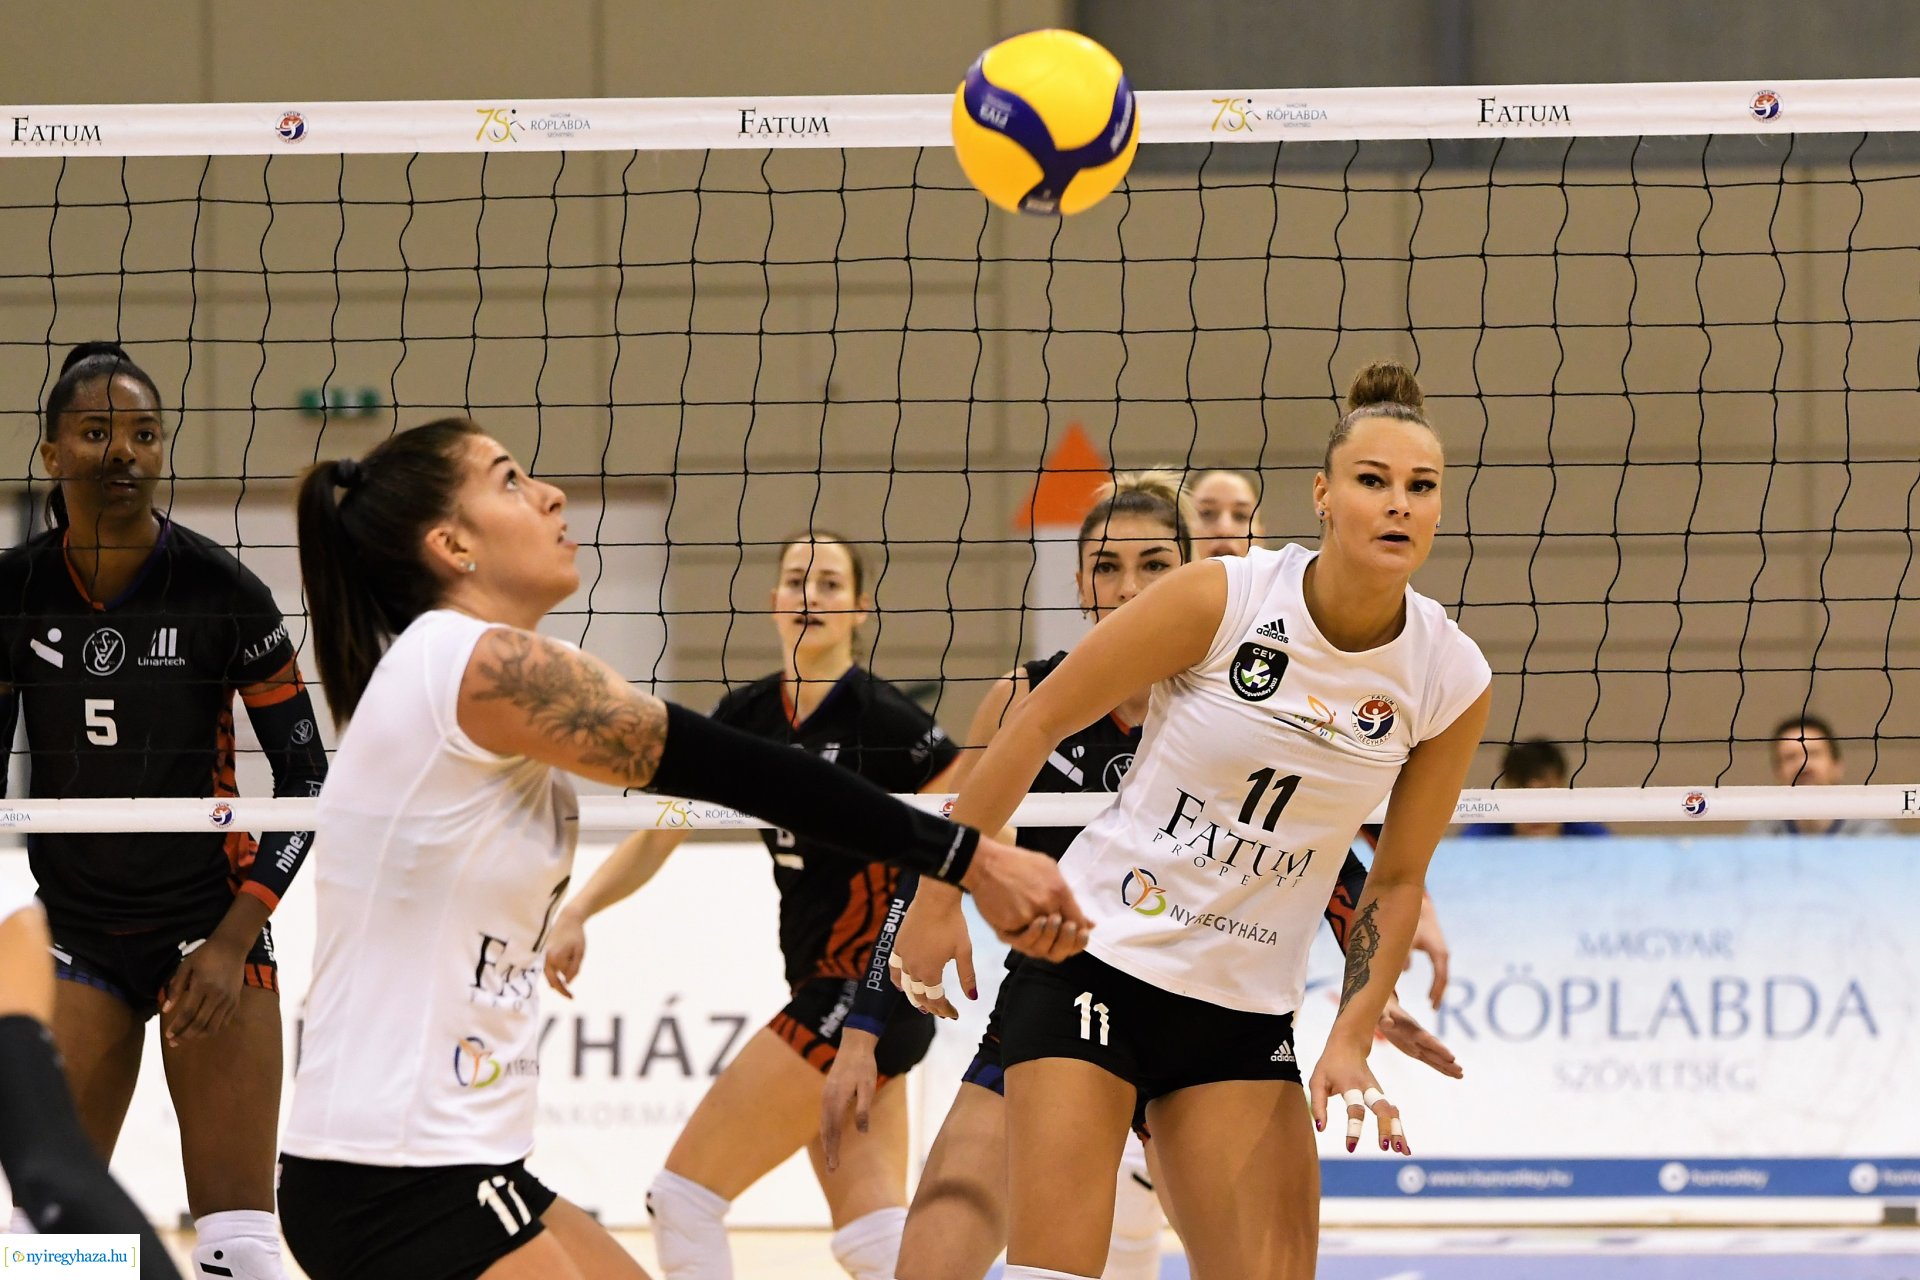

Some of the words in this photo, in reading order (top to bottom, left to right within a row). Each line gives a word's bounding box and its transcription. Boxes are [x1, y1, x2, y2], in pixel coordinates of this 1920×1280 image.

[530, 118, 591, 131] RÖPLABDA
[1266, 108, 1328, 121] RÖPLABDA
[1252, 647, 1276, 660] CEV
[1256, 627, 1290, 644] adidas
[137, 657, 186, 667] Linartech
[84, 698, 118, 747] 5
[1238, 766, 1303, 833] 11
[866, 898, 906, 992] ninesquared
[1169, 904, 1278, 946] NYREGYHÁZA
[1073, 991, 1110, 1046] 11
[1434, 963, 1882, 1041] RÖPLABDA
